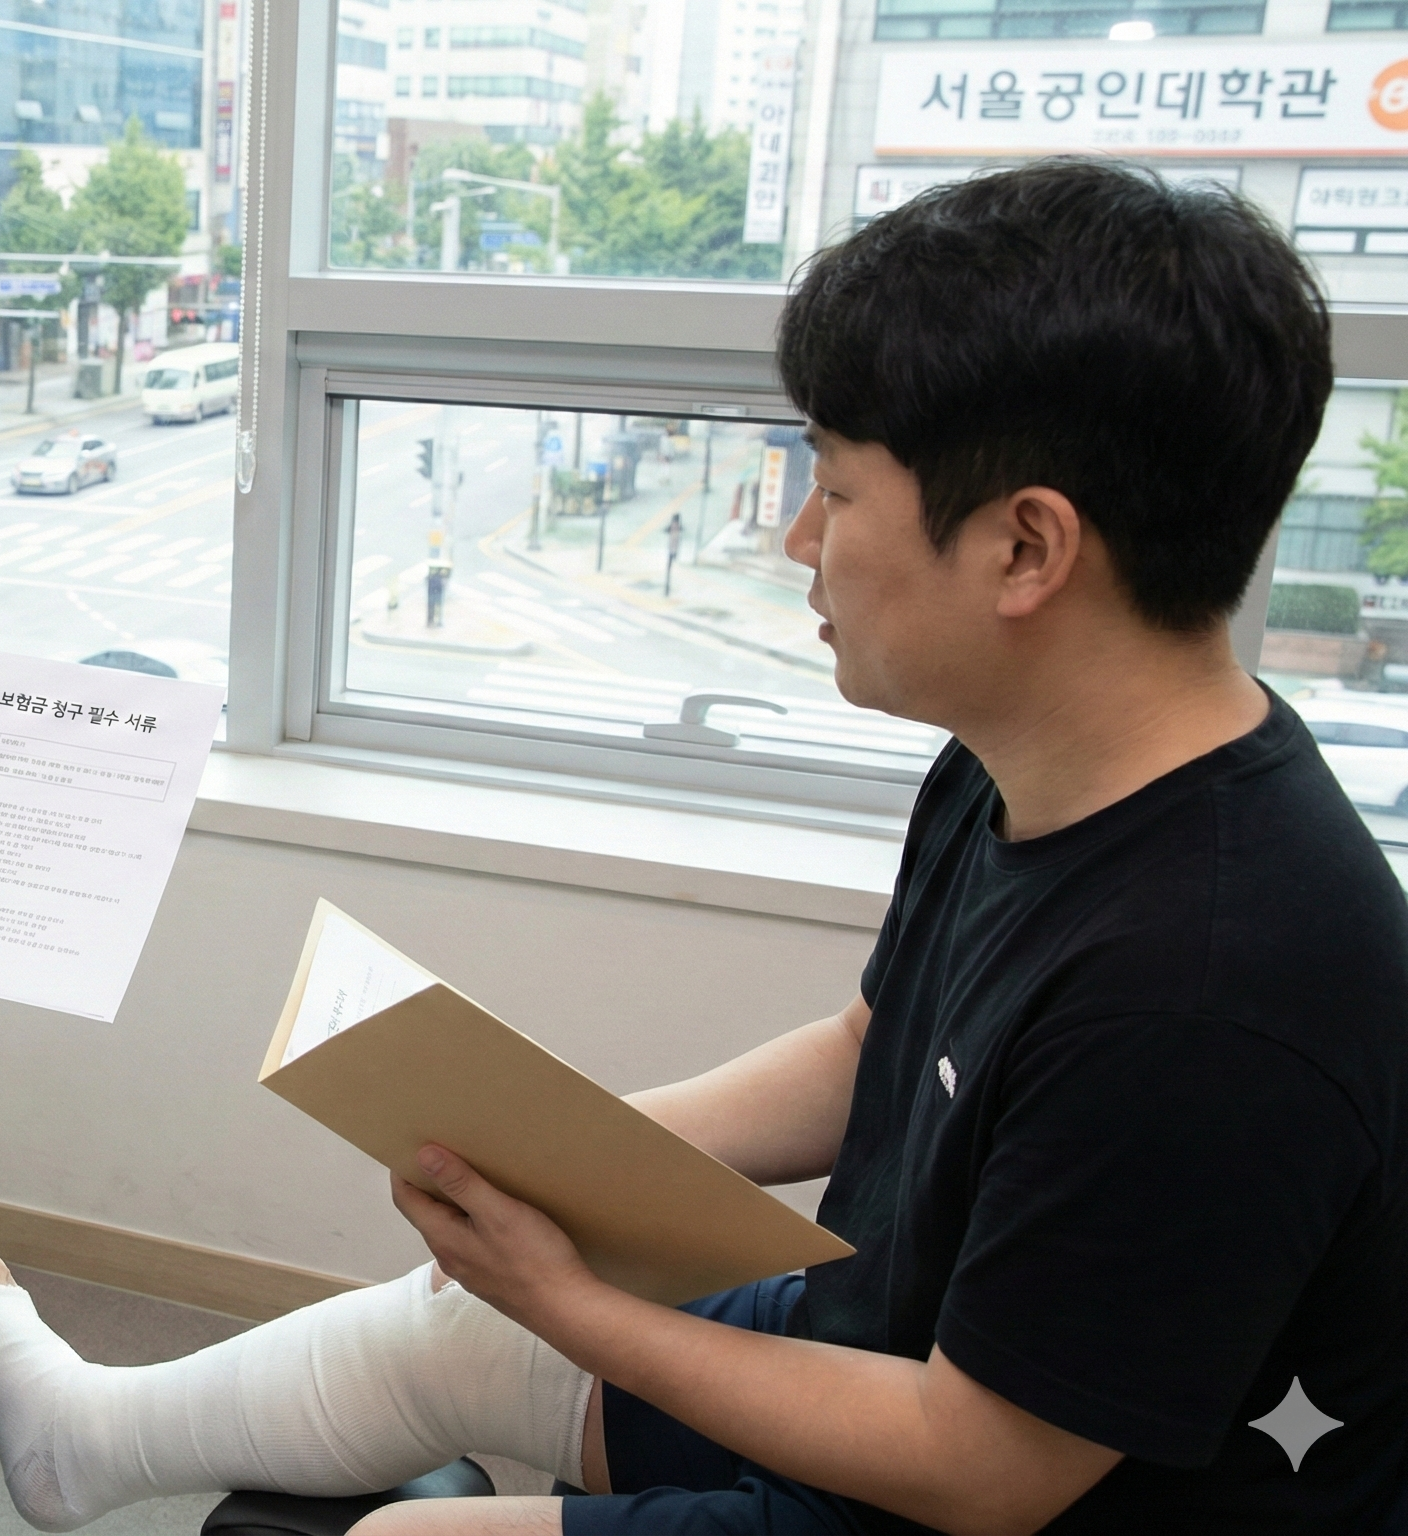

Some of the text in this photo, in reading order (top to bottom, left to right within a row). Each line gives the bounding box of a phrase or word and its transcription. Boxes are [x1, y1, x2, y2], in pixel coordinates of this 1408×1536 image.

[921, 68, 1337, 122] 서울공인데학관
[51, 699, 84, 721] 청구
[124, 713, 157, 734] 서류
